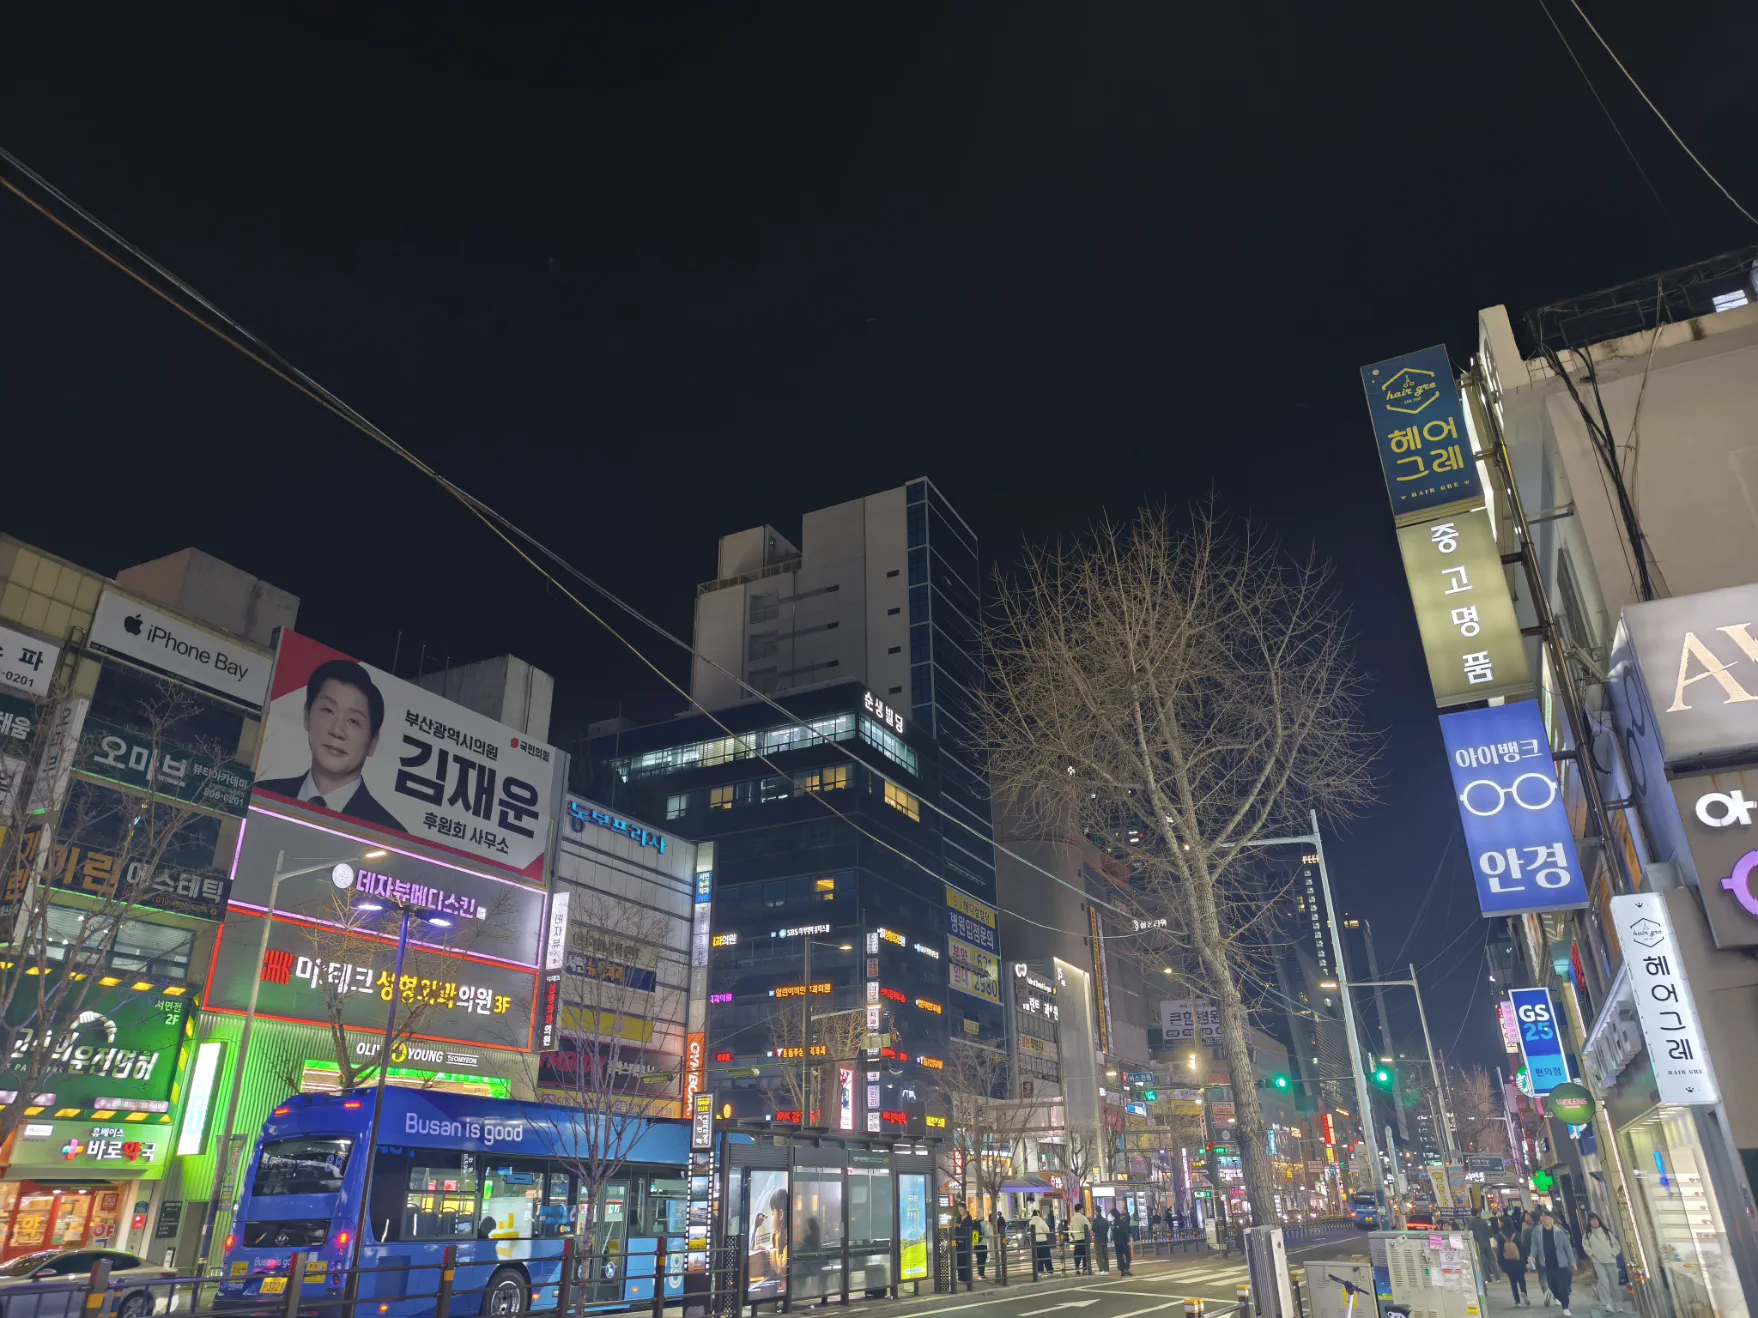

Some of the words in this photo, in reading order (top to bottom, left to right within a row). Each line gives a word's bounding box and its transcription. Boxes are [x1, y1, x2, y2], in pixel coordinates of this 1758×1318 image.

[1386, 388, 1412, 400] hair
[1414, 382, 1436, 397] gre
[1387, 416, 1458, 453] 헤어
[1396, 444, 1464, 482] 그레
[1411, 487, 1436, 498] HAIR
[1440, 481, 1459, 491] GRE
[1431, 522, 1493, 685] 중고명품
[147, 624, 210, 665] iPhone
[214, 652, 249, 682] Bay
[405, 709, 499, 762] 부산광역시의원
[520, 740, 550, 763] 국민의힘
[1455, 738, 1543, 768] 아이뱅크
[192, 763, 248, 789] 뷰티아카데미
[394, 733, 540, 840] 김재운
[422, 811, 467, 840] 후원회
[469, 827, 510, 855] 사무소
[566, 800, 667, 856] 동부프라자
[1479, 842, 1572, 893] 안경
[494, 996, 512, 1014] 3F
[1518, 1004, 1550, 1022] GS
[1643, 956, 1694, 1060] 헤어그레
[165, 1014, 180, 1025] 2F
[1524, 1023, 1554, 1041] 25
[407, 1049, 444, 1063] YOUNG
[1535, 1068, 1562, 1077] 편의점
[91, 1127, 124, 1138] 휴베이스
[405, 1112, 462, 1137] Busan
[465, 1118, 480, 1138] is
[483, 1124, 523, 1145] good
[87, 1139, 157, 1162] 바로약국
